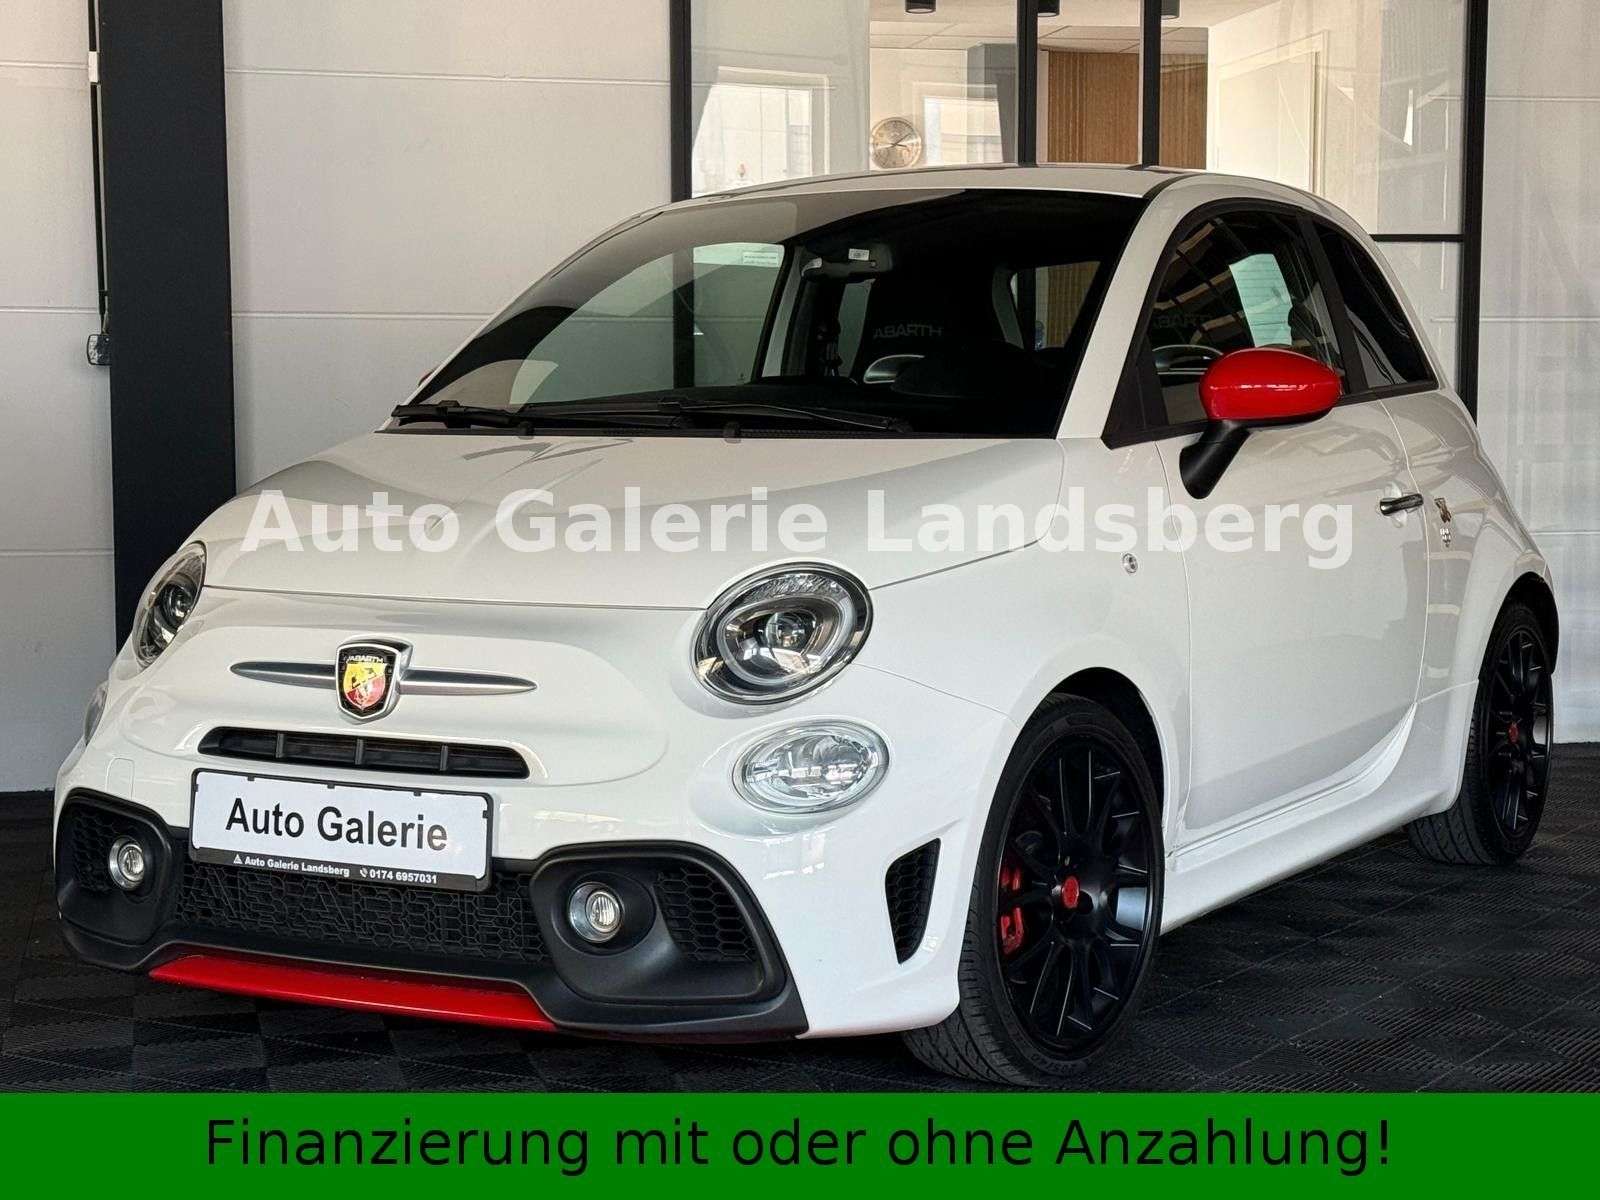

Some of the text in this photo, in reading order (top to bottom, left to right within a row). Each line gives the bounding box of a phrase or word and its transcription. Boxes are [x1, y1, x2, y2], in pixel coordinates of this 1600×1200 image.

[226, 798, 449, 852] Auto Galerie
[245, 855, 438, 884] Auto Galerie Landsberg 0174 6957031
